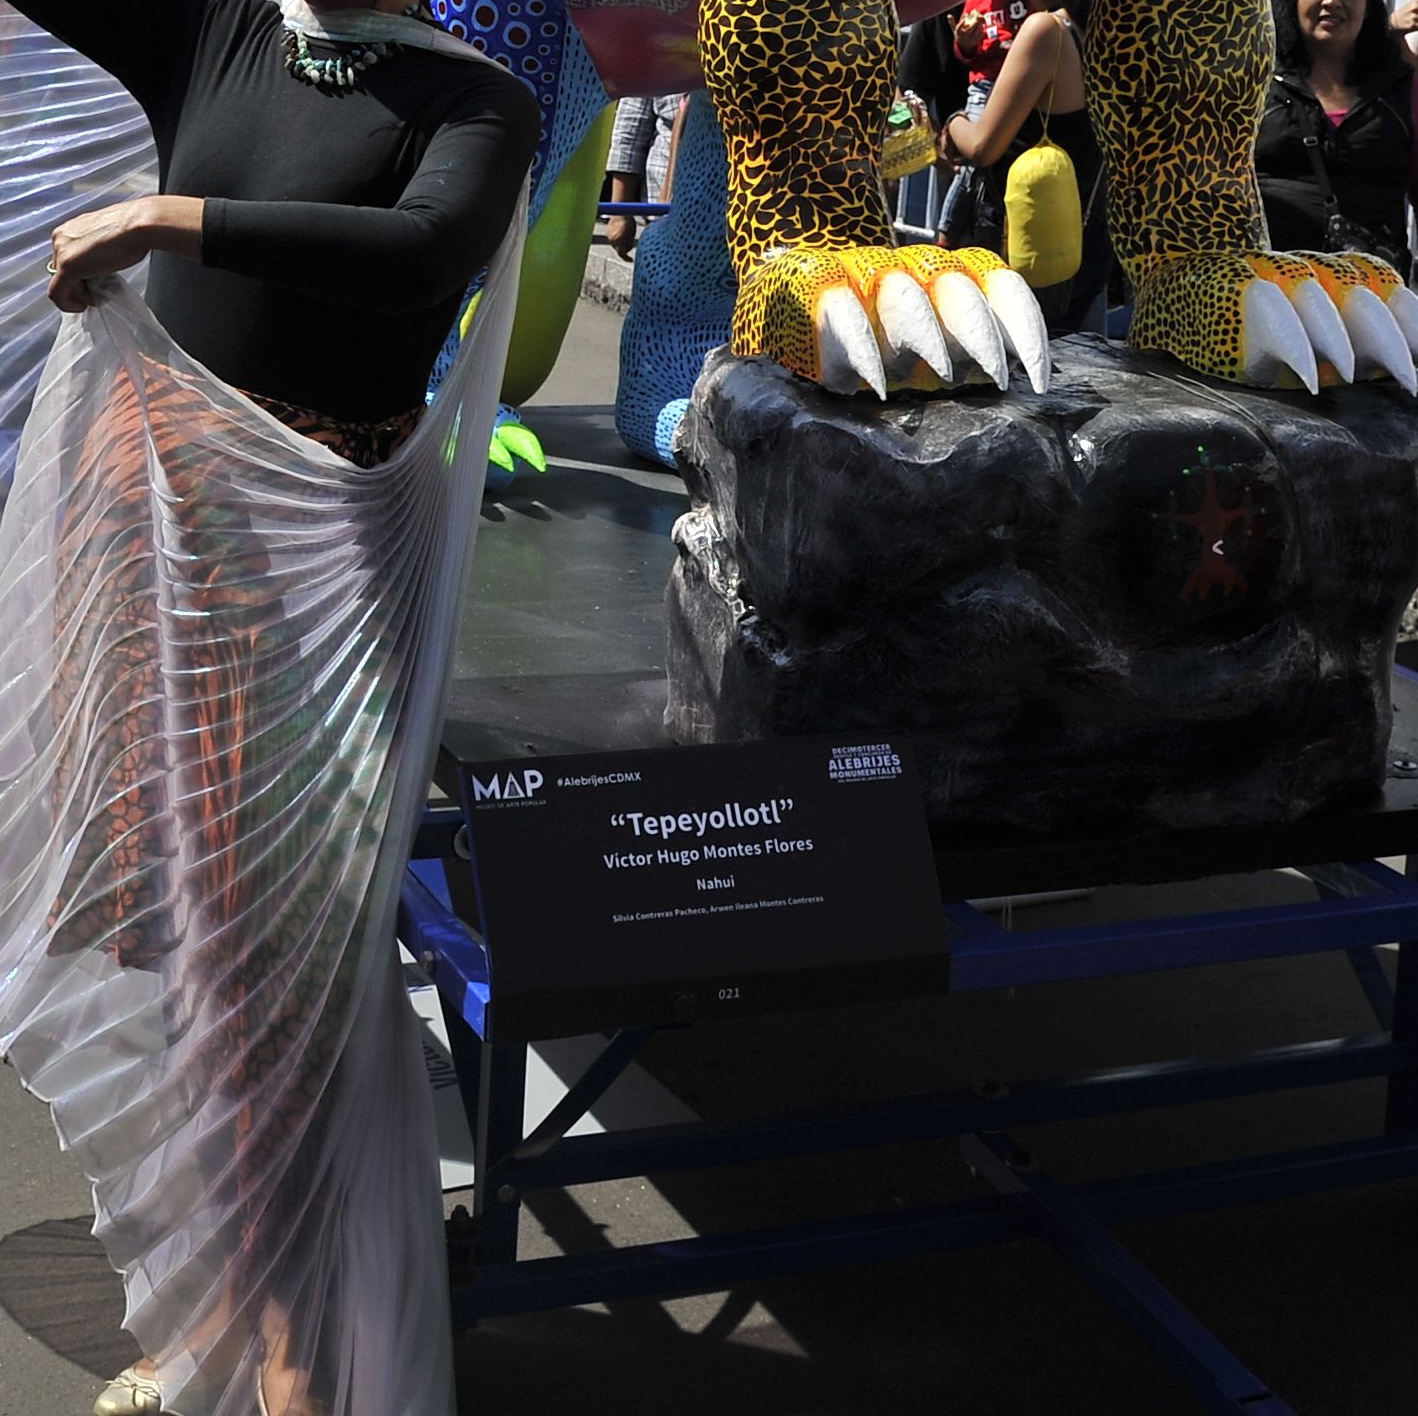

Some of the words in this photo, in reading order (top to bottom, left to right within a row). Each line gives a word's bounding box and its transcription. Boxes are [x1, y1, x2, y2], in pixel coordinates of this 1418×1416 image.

[829, 754, 901, 771] ALEBRIJES
[557, 771, 642, 787] #AlebrijesCDMX
[829, 766, 903, 779] MONUMENTALES
[471, 769, 544, 801] MAP
[657, 847, 700, 866] Hugo
[703, 843, 762, 860] Montes
[764, 838, 814, 854] Flores
[635, 909, 674, 920] Contreras
[674, 906, 709, 918] Pacheco,
[788, 896, 824, 905] Contreras
[718, 988, 741, 1000] 021
